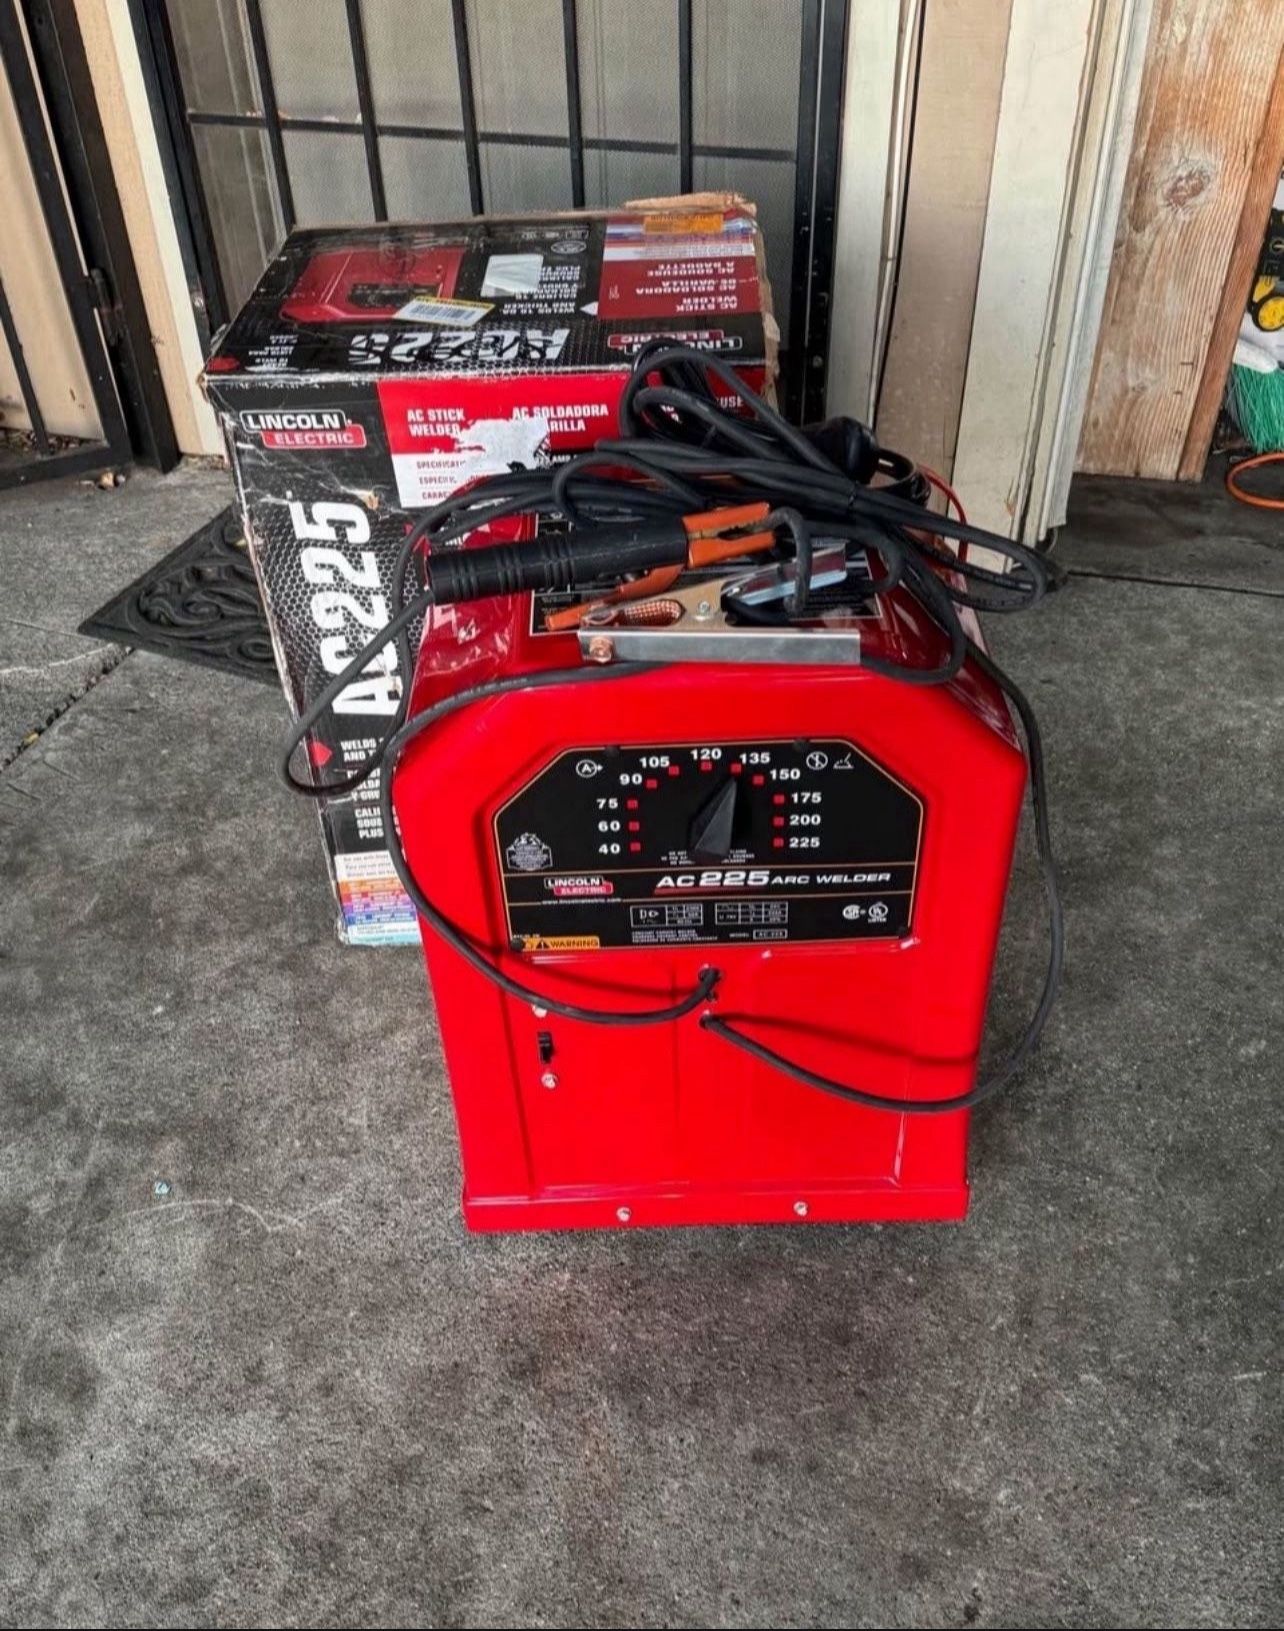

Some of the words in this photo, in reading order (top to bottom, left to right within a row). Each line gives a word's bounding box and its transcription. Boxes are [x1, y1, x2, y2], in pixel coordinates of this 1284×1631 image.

[676, 303, 716, 313] STICK
[407, 409, 424, 422] AC
[427, 408, 465, 422] STICK
[512, 406, 530, 420] AC
[533, 404, 609, 419] SOLDADORA
[247, 414, 341, 431] LINCOLN
[409, 423, 461, 437] WELDER
[273, 431, 356, 446] ELECTRIC
[290, 500, 401, 717] AC225
[341, 738, 377, 751] WELDS
[343, 750, 366, 762] AND
[690, 748, 722, 761] 120
[739, 752, 771, 765] 135
[639, 756, 670, 769] 105
[619, 773, 643, 786] 90
[770, 768, 801, 780] 150
[596, 798, 619, 810] 75
[791, 792, 822, 804] 175
[598, 820, 621, 832] 60
[789, 814, 821, 826] 200
[359, 828, 385, 840] PLUS
[598, 843, 621, 855] 40
[789, 837, 821, 849] 225
[547, 877, 600, 889] LINCOLN
[656, 874, 696, 889] AC
[698, 870, 770, 888] 225
[771, 874, 811, 886] ARC
[816, 872, 891, 885] WELDER
[549, 938, 598, 949] WARNING
